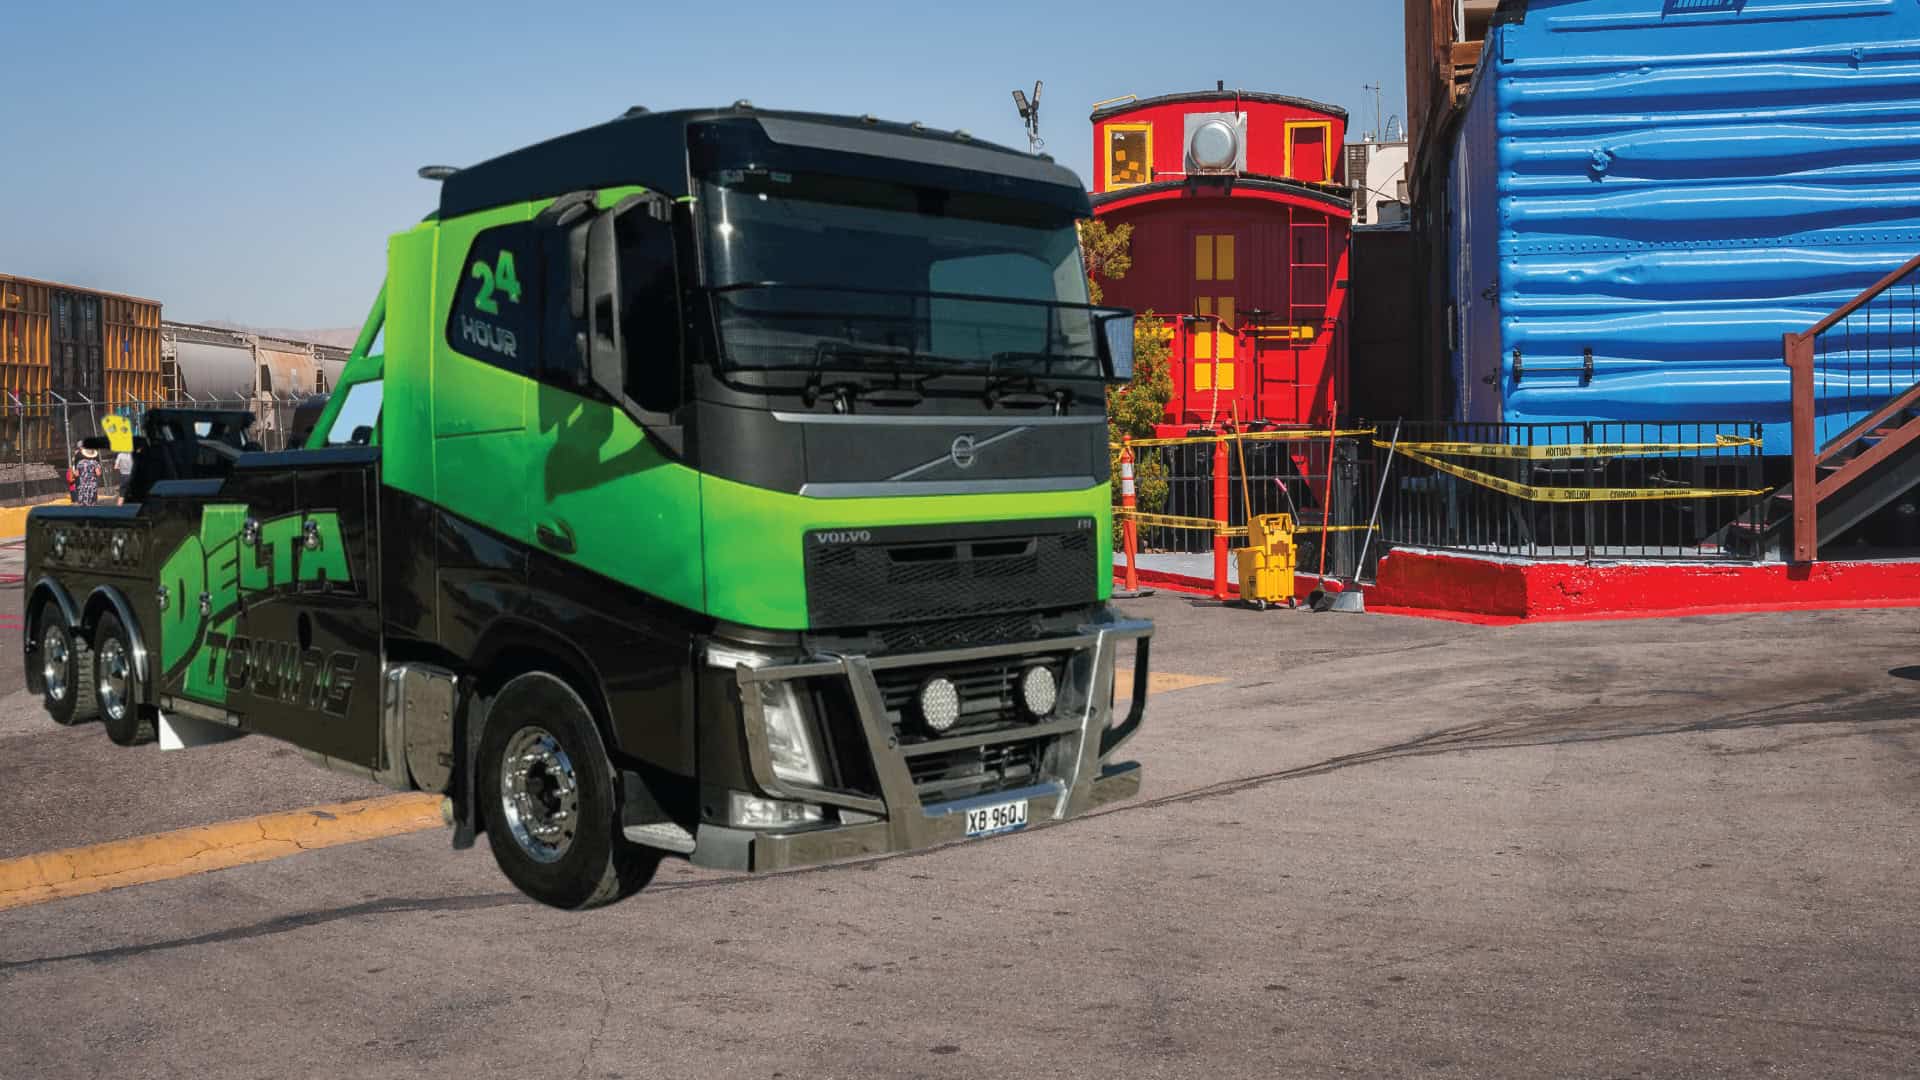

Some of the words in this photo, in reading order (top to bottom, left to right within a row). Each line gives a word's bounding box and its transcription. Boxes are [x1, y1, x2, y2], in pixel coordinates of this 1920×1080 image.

[471, 249, 522, 315] 24
[461, 314, 517, 358] HOUR
[816, 530, 872, 544] VOLVO
[160, 504, 350, 676] DELTA
[182, 614, 360, 718] TOWING
